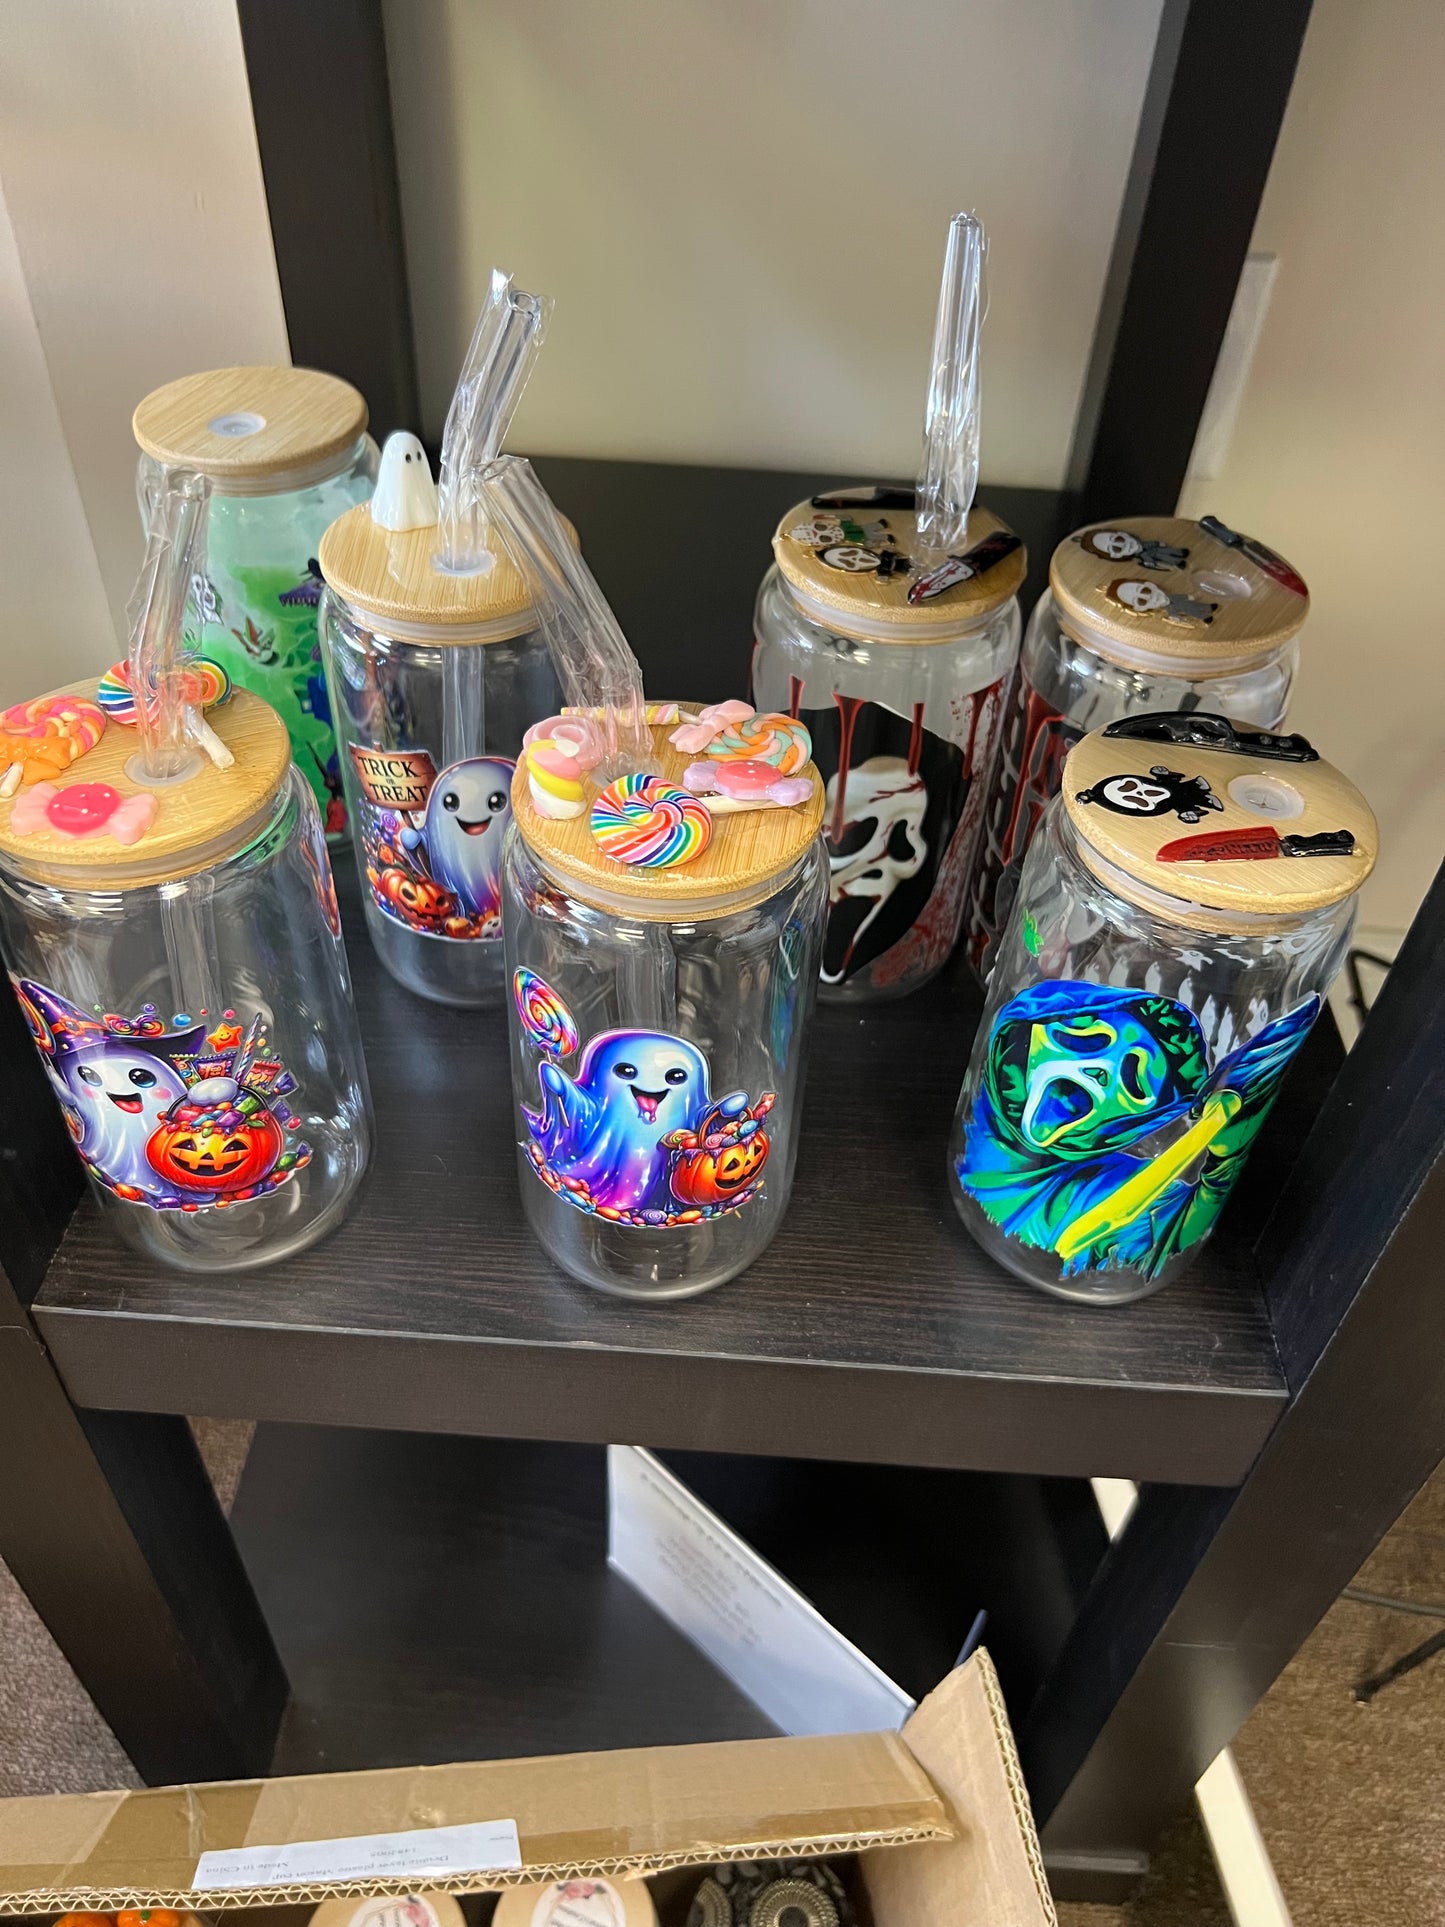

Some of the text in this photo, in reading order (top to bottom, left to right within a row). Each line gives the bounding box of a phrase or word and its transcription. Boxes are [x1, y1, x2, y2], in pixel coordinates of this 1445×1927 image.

[357, 756, 421, 778] TRICK
[368, 783, 427, 802] TREAT
[205, 1864, 240, 1874] China
